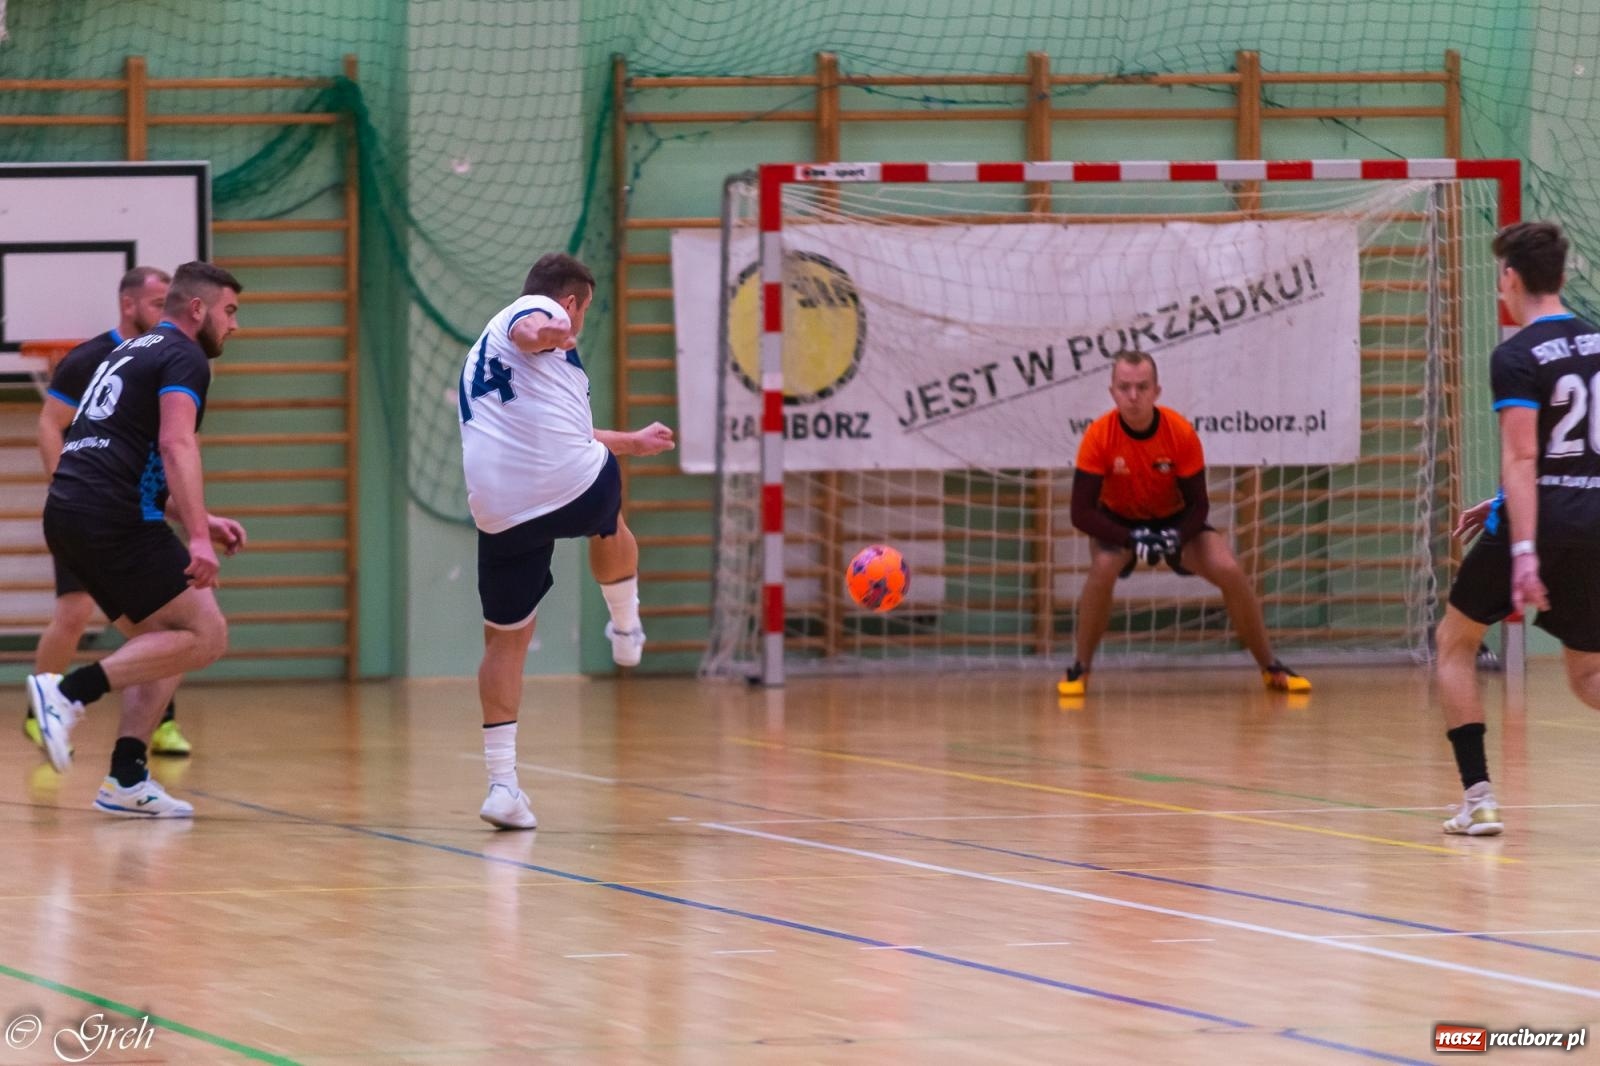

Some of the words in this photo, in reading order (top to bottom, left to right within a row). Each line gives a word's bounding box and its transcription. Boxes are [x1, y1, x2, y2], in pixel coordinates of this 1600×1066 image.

[898, 362, 999, 427] JEST
[1012, 345, 1056, 387] W
[1067, 258, 1318, 372] PORZĄDKU!
[730, 411, 872, 442] RAIBORZ
